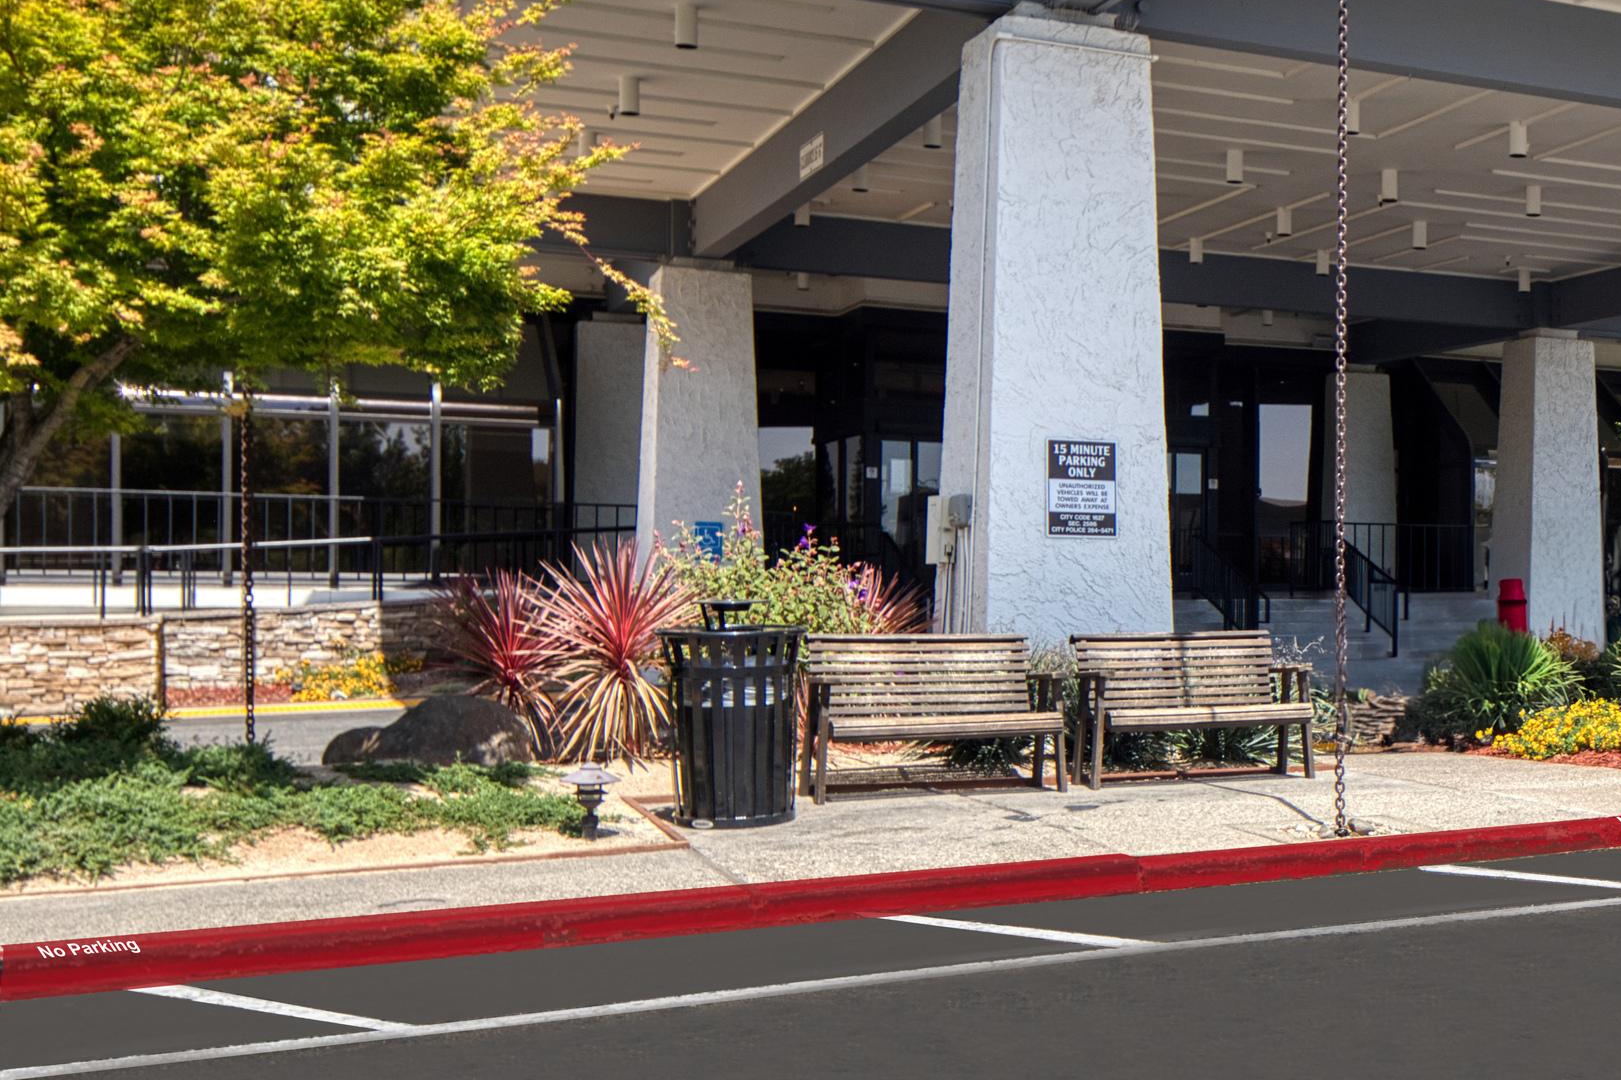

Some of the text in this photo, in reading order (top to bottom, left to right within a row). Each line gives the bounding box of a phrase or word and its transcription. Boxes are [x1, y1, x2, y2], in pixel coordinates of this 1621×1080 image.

[1053, 443, 1111, 456] 15 MINUTE
[1058, 454, 1106, 467] PARKING
[1068, 466, 1096, 478] ONLY
[1058, 482, 1106, 490] UNAUTHORIZED
[37, 939, 141, 959] No Parking
